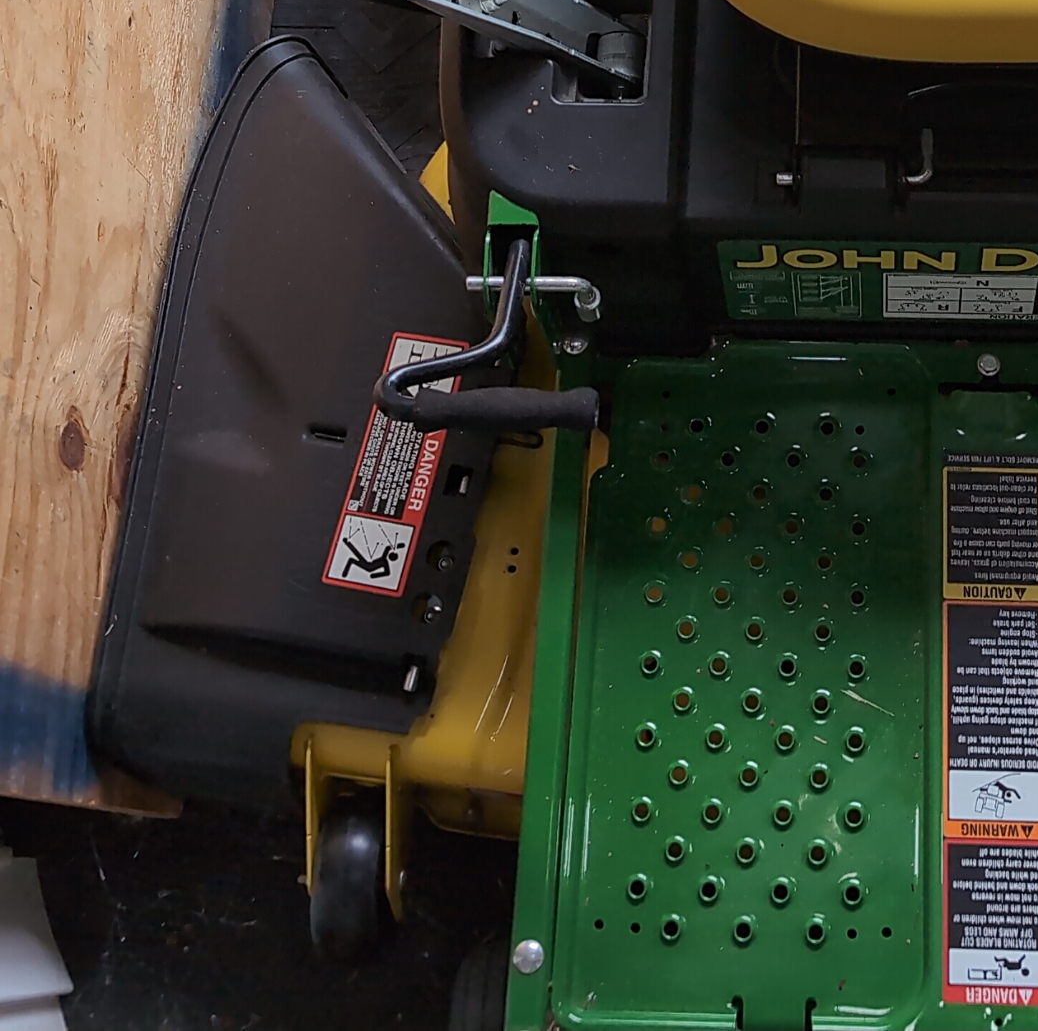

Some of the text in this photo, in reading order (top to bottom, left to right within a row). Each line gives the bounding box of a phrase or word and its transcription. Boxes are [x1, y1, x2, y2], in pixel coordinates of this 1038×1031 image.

[736, 244, 957, 272] JOHN
[380, 421, 407, 500] THROWN OBJECTS
[398, 430, 423, 500] OTATING BLADE
[407, 438, 438, 512] DANGER
[963, 586, 1012, 599] CAUTION
[1011, 727, 1027, 735] down
[950, 758, 968, 766] DEATH
[970, 759, 977, 767] OR
[979, 759, 999, 768] INJURY
[1001, 759, 1025, 768] SERIOUS
[961, 824, 1019, 837] WARNING
[972, 892, 995, 900] reverse
[997, 893, 1003, 901] in
[1021, 894, 1032, 902] not
[987, 904, 1008, 912] around
[962, 914, 986, 923] children
[988, 915, 1004, 924] when
[1023, 916, 1032, 925] not
[964, 926, 1033, 937] OFF ARMS AND LEGS
[961, 936, 1036, 948] ROTATING BLADES CUT
[966, 987, 1018, 1004] DANGER
